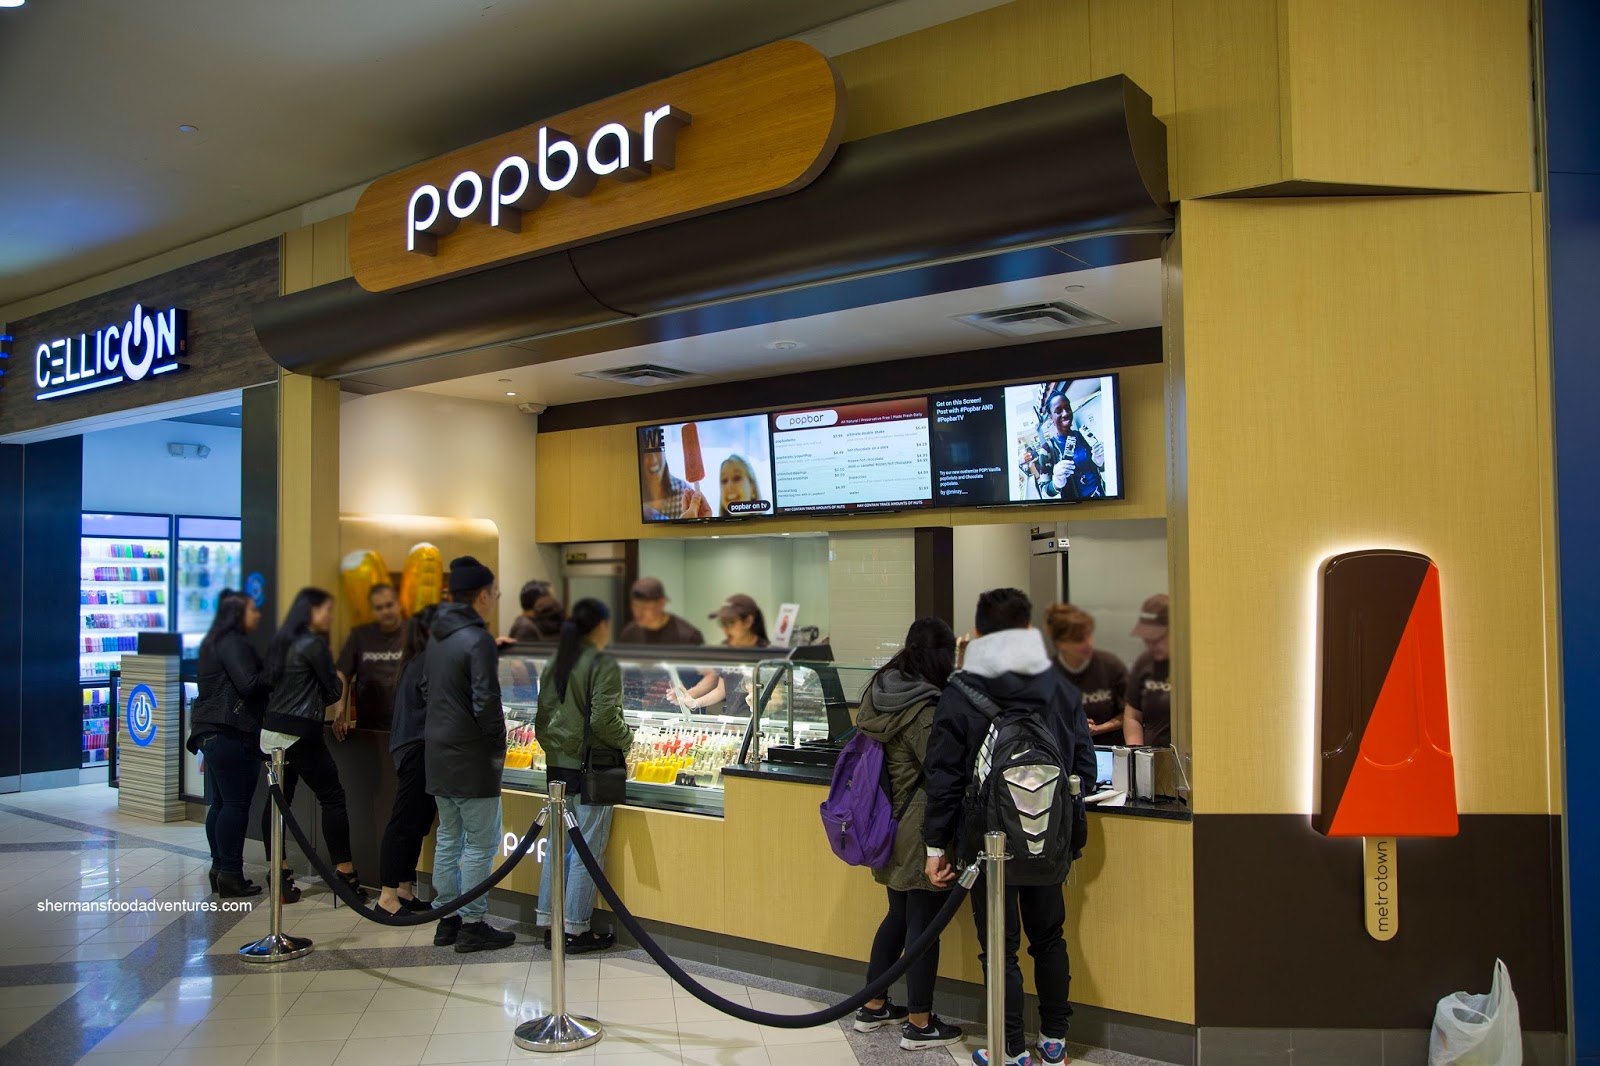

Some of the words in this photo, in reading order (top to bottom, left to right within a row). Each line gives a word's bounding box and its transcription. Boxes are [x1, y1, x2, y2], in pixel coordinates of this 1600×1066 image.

[407, 104, 671, 251] popbar
[789, 414, 824, 426] popbar
[730, 503, 751, 511] popbar
[1374, 841, 1388, 932] metrotown
